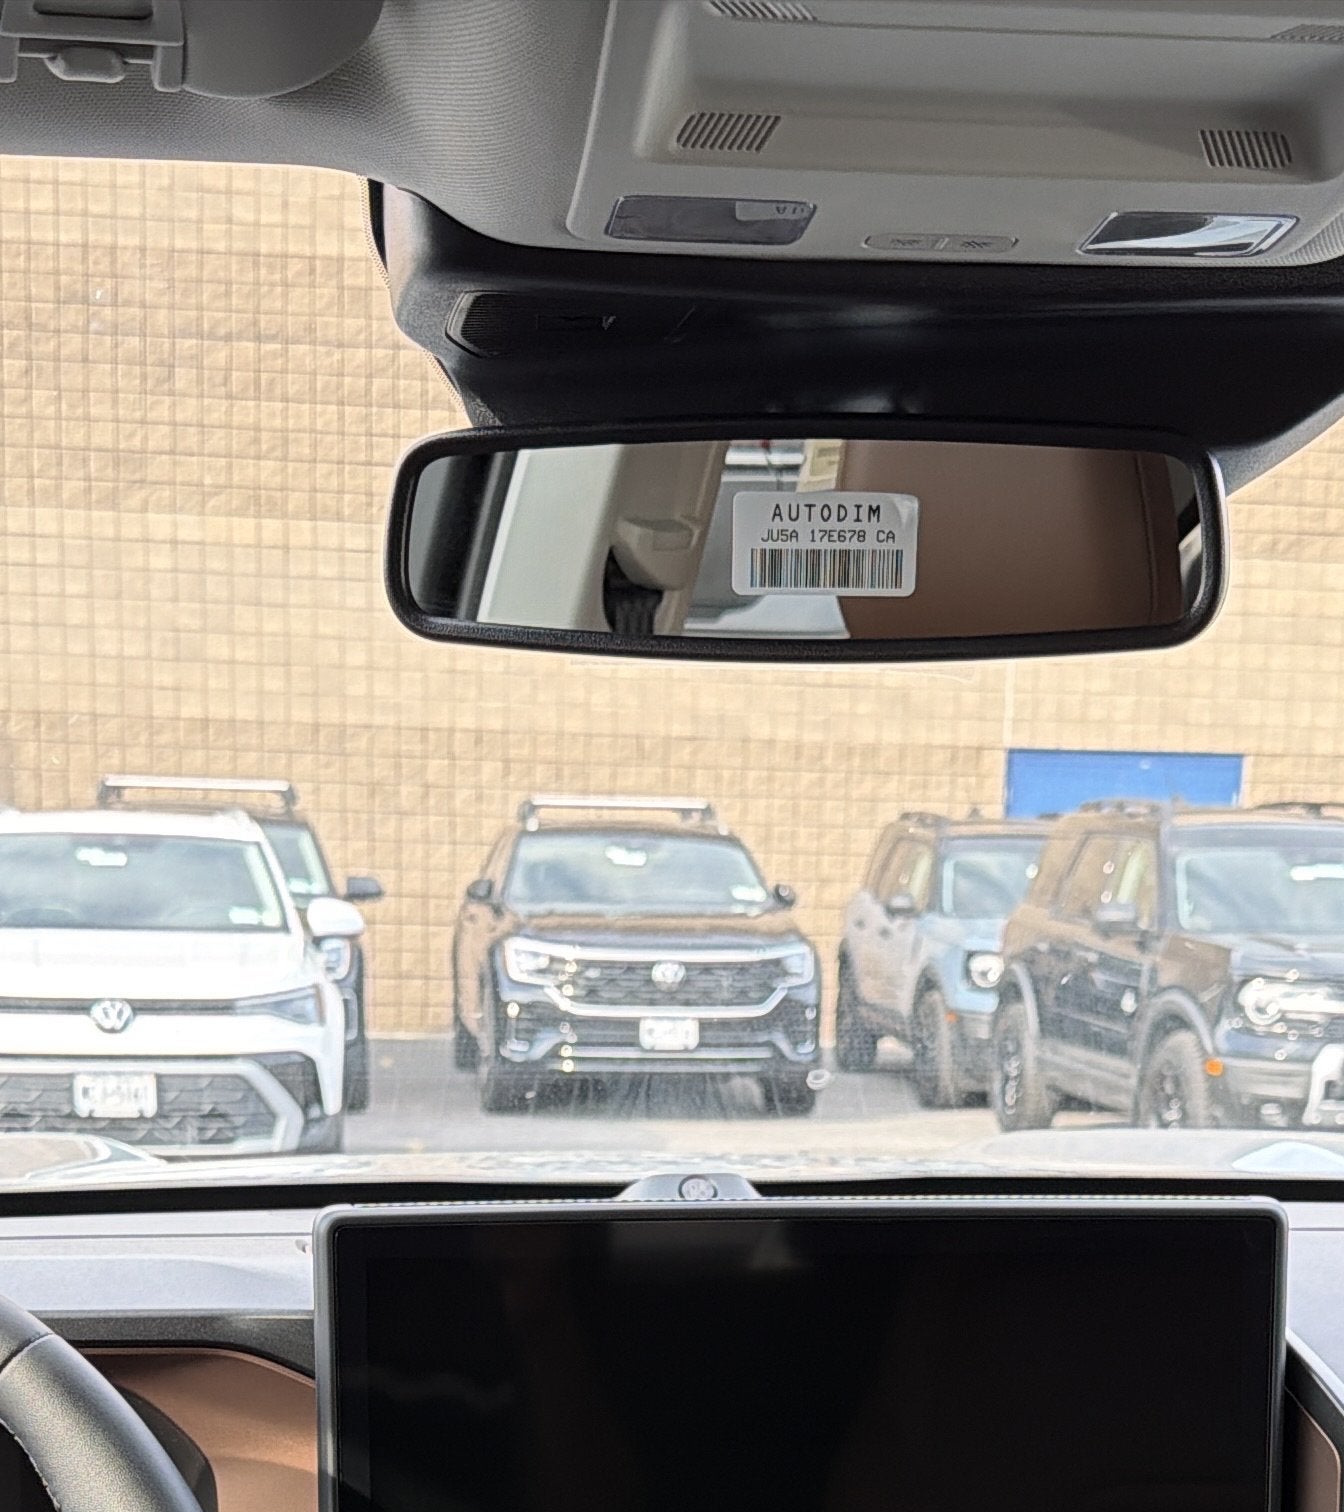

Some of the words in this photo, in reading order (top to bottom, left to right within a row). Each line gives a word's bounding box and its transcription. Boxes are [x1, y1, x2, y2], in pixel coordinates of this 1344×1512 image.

[771, 503, 882, 523] AUTODIM
[760, 529, 799, 543] JU5A
[809, 529, 867, 543] 17E678
[875, 530, 896, 543] CA
